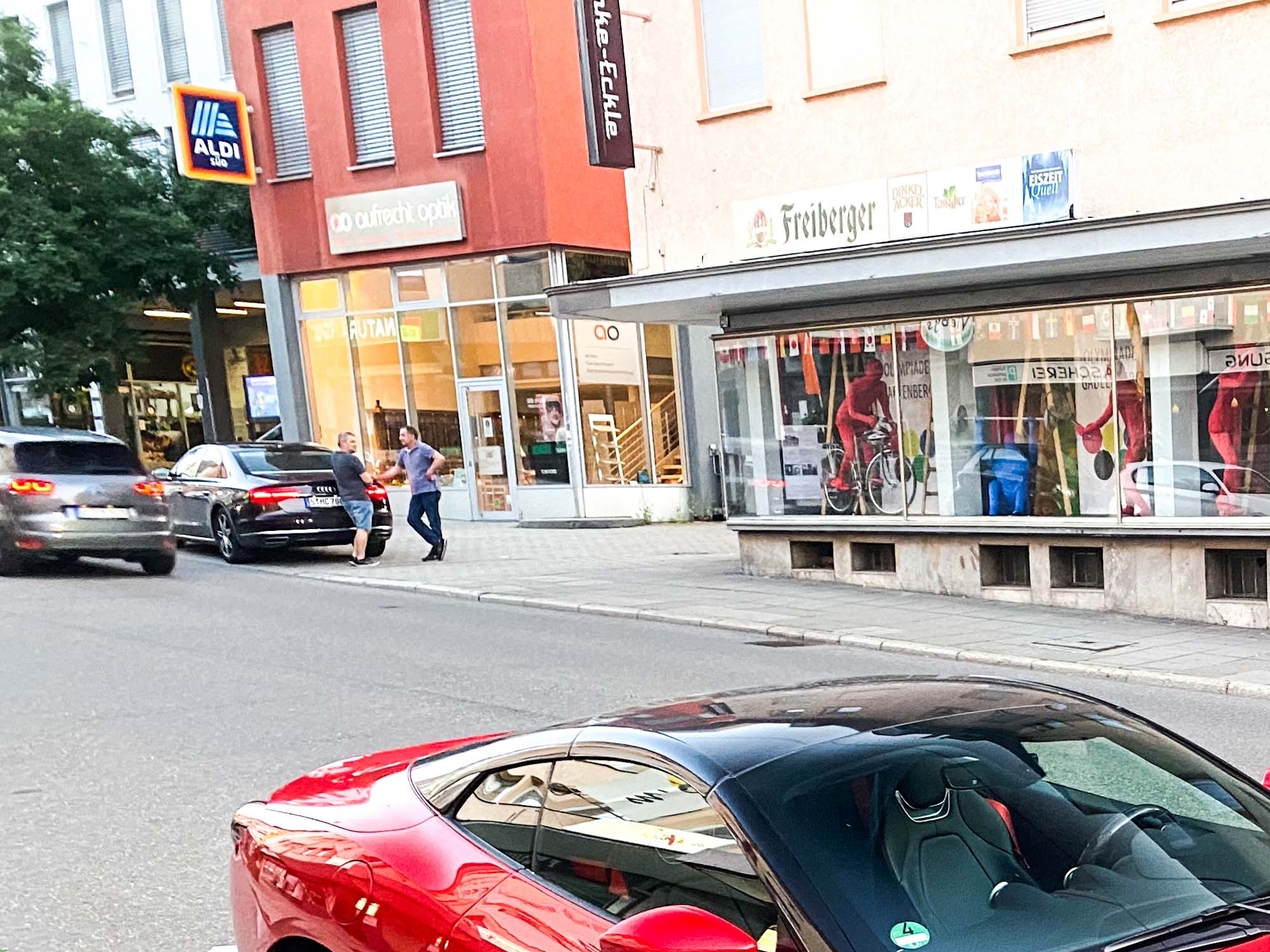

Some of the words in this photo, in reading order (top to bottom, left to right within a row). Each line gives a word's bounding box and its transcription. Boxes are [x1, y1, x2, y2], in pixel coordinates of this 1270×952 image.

[194, 138, 240, 160] ALDI
[209, 156, 229, 168] SÜD
[1028, 170, 1064, 187] EISZEIT
[1031, 182, 1059, 200] Quell
[354, 200, 415, 230] aufrecht
[417, 193, 458, 227] optik
[780, 201, 877, 244] Freiberger
[903, 922, 914, 935] 4
